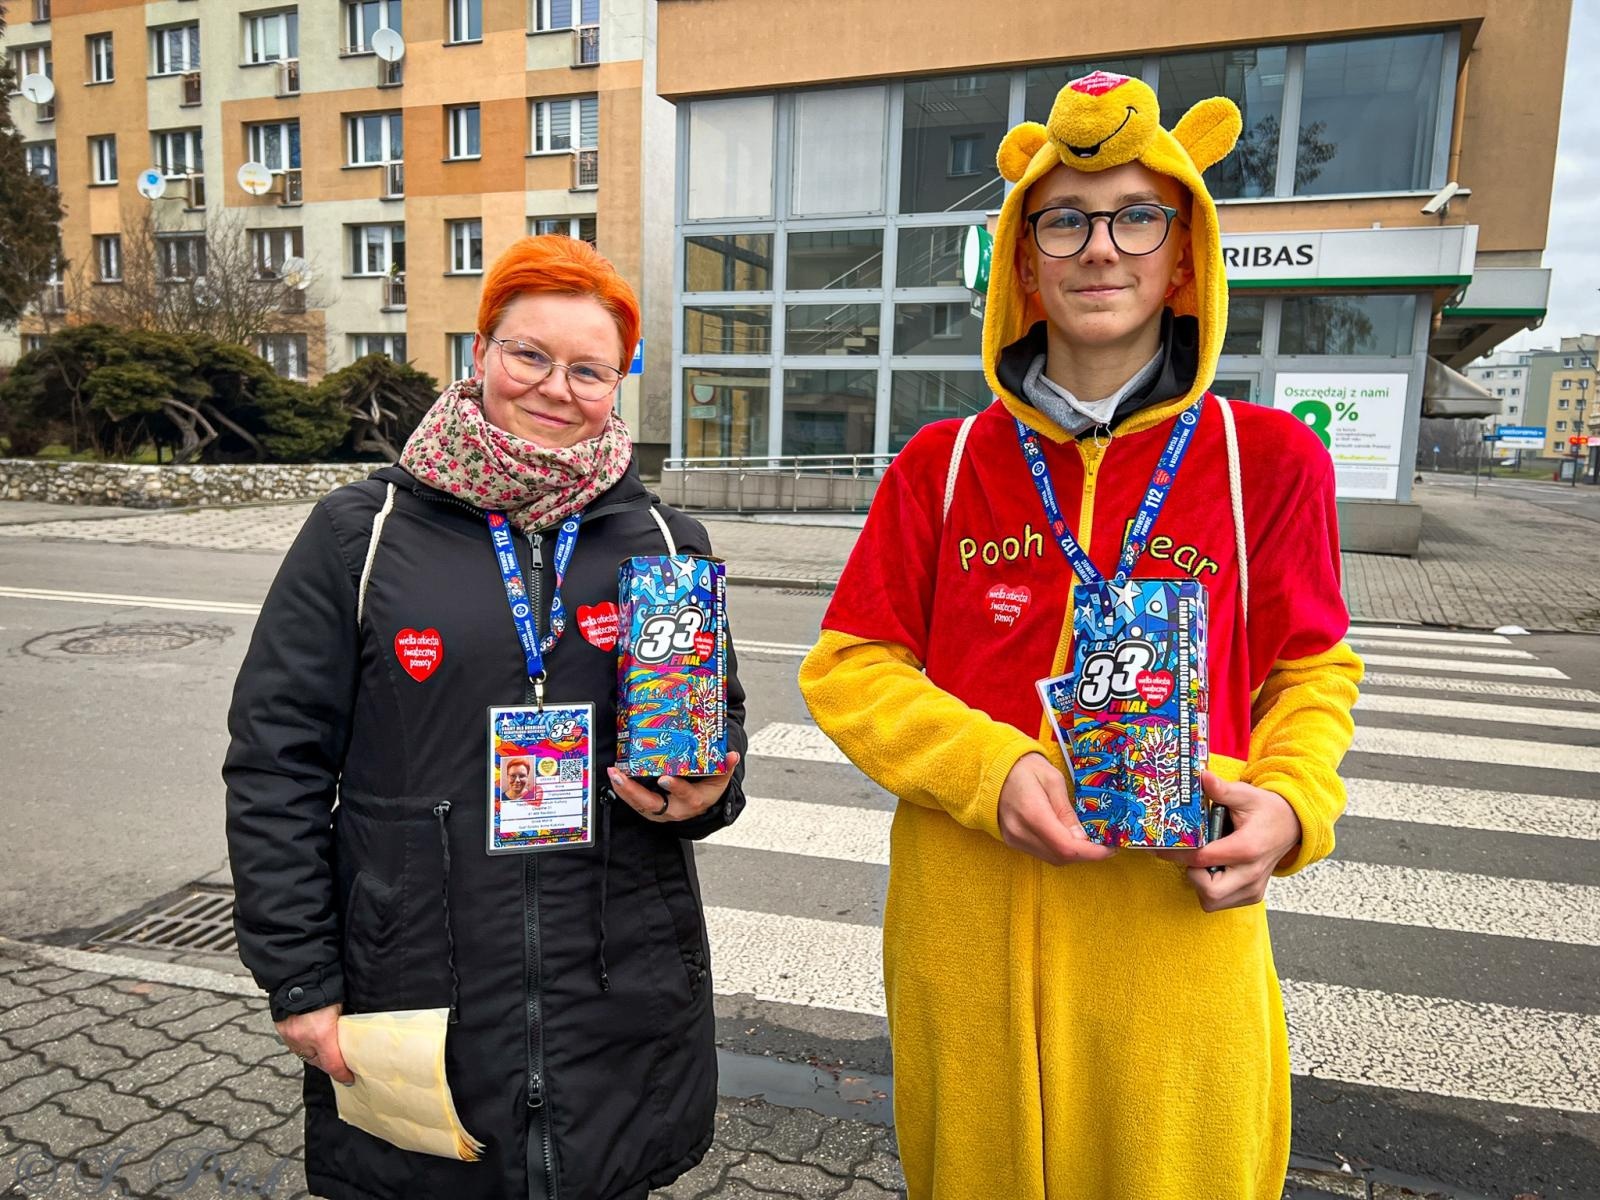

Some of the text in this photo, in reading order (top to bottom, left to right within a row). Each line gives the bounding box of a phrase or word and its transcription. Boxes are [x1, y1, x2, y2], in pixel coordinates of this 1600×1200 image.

[1222, 244, 1313, 267] RIBAS
[1284, 386, 1347, 399] Oszczędzaj
[1360, 387, 1390, 398] nami
[1144, 488, 1163, 509] 112
[1132, 510, 1147, 537] PIERWSZA
[1140, 516, 1152, 537] POMOC
[493, 530, 510, 548] 112
[1061, 535, 1079, 558] 112
[1080, 559, 1098, 578] POMOC
[989, 588, 1028, 603] wielka orkiestra
[647, 605, 678, 615] 2025
[990, 600, 1021, 618] świątecznej
[1178, 600, 1188, 631] GRAMY
[994, 613, 1015, 627] pomocy
[398, 634, 416, 645] wielka
[637, 608, 704, 661] 33
[1179, 632, 1189, 648] DLA
[1087, 640, 1116, 652] 2025
[409, 659, 432, 670] pomocy
[1079, 643, 1153, 706] 33
[1179, 649, 1190, 694] ONKOLOGII
[550, 719, 577, 741] 33
[1180, 700, 1190, 756] HEMATOLOGII
[1181, 757, 1191, 803] DZIECIĘCEJ
